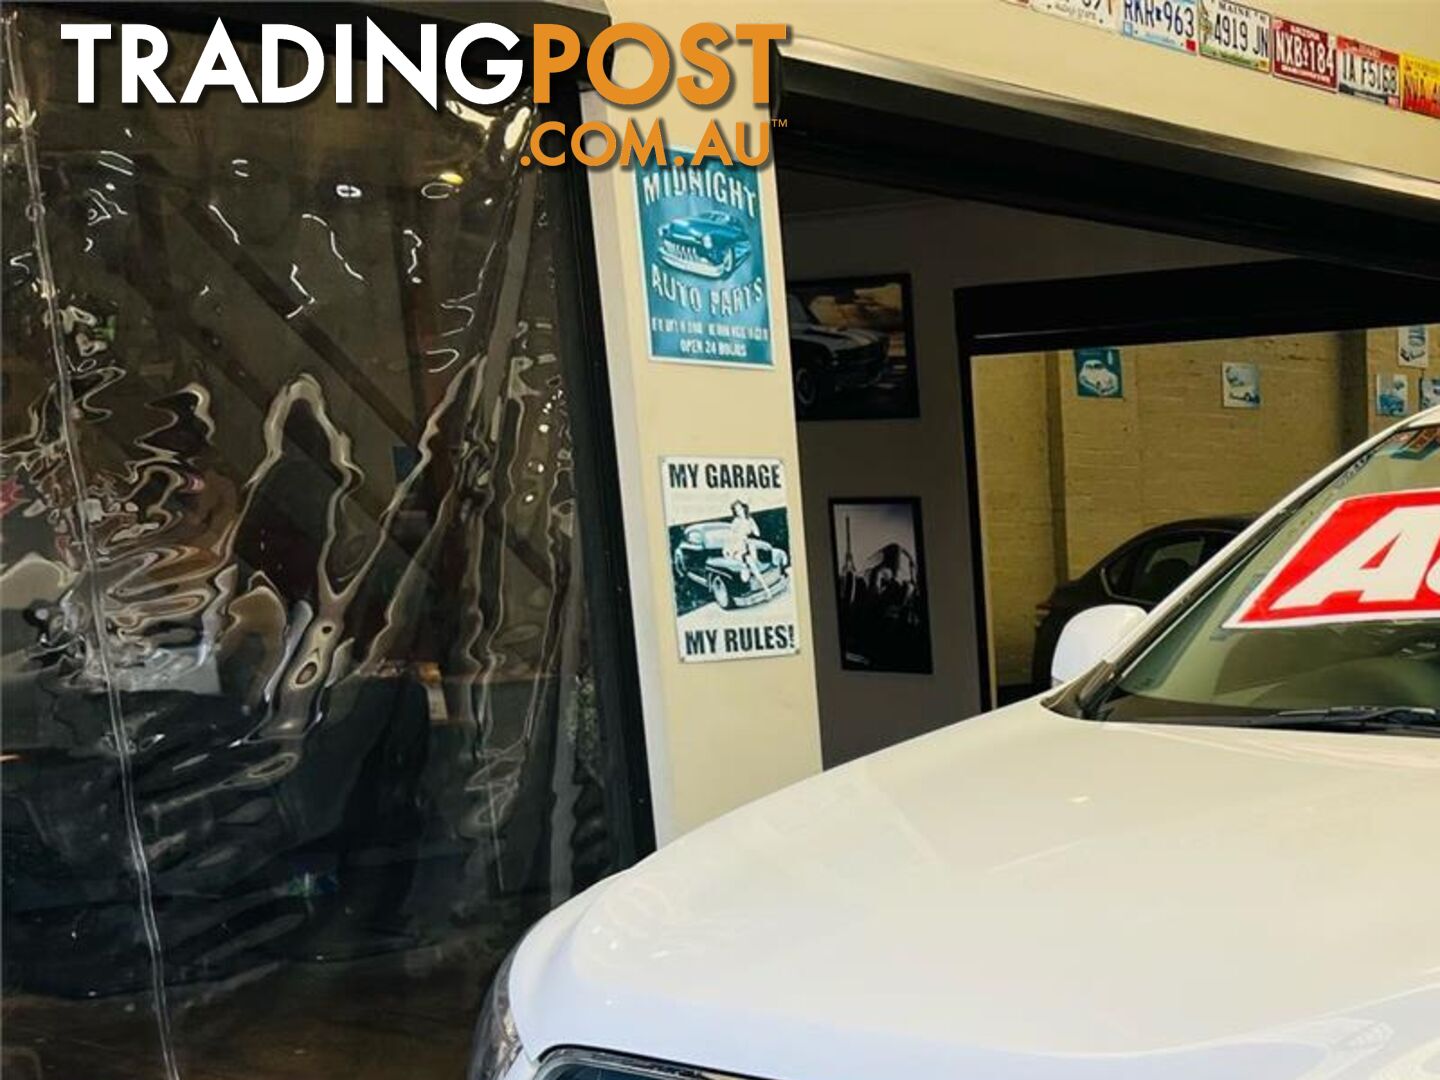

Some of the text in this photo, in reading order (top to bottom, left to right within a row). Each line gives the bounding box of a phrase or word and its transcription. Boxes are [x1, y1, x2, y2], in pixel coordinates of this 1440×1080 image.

[1163, 1, 1194, 38] 963
[1214, 13, 1248, 52] 4919
[642, 162, 757, 219] MIDNIGHT
[650, 262, 765, 318] AUTO PARTS
[668, 463, 782, 489] MY GARAGE
[684, 623, 795, 656] MY RULES!
